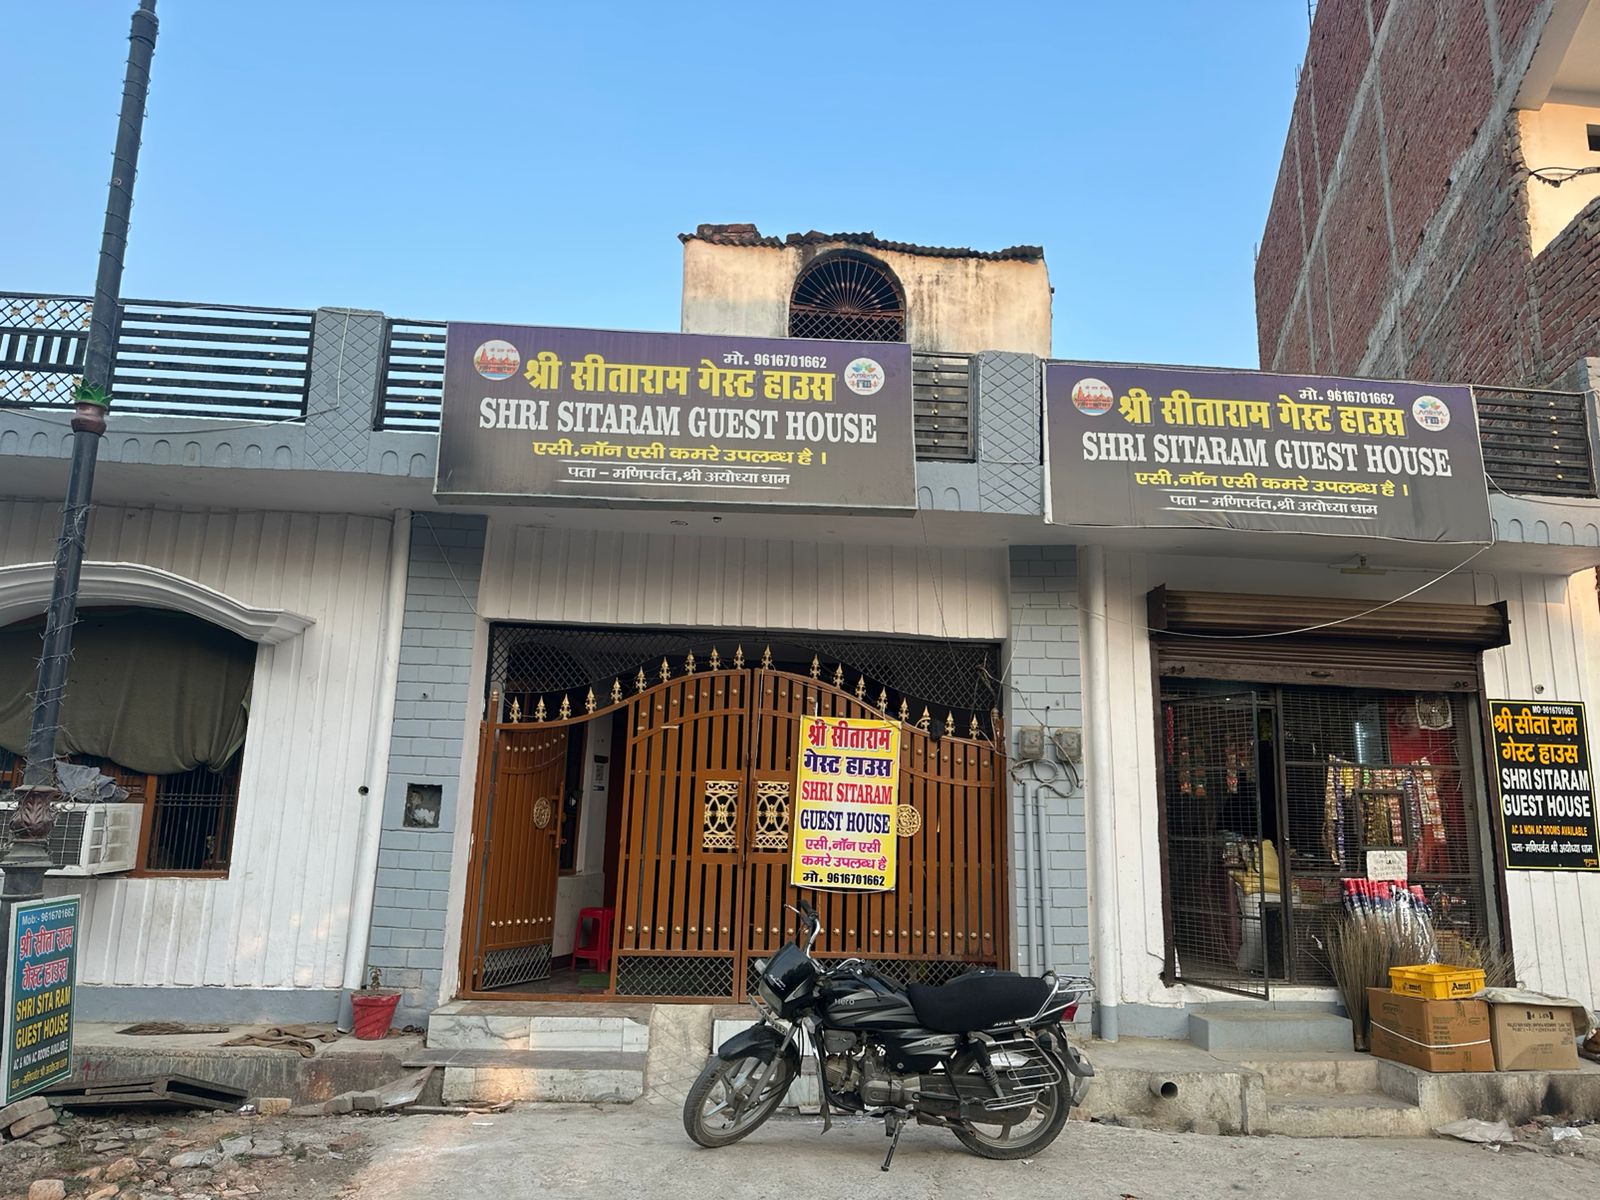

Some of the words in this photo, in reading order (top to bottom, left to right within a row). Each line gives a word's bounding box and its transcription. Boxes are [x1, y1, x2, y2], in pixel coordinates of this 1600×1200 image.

[723, 351, 749, 366] मो.
[754, 353, 827, 369] 9616701662
[524, 351, 563, 390] श्री
[570, 354, 691, 396] सीताराम
[698, 359, 756, 398] गेस्ट
[763, 371, 836, 402] हाउस
[1298, 387, 1324, 401] मो.
[1327, 389, 1396, 405] 9616701662
[479, 397, 549, 431] SHRI
[557, 401, 681, 436] SITARAM
[688, 407, 778, 440] GUEST
[785, 411, 877, 444] HOUSE
[1118, 388, 1153, 424] श्री
[1160, 390, 1271, 429] सीताराम
[1277, 394, 1332, 431] गेस्ट
[1337, 406, 1406, 437] हाउस
[627, 442, 666, 460] एसी
[669, 445, 719, 462] कमरे
[723, 450, 795, 464] उपलब्ध
[797, 448, 813, 466] है
[1082, 431, 1148, 462] SHRI
[1153, 434, 1269, 467] SITARAM
[1275, 439, 1359, 472] GUEST
[1363, 444, 1453, 477] HOUSE
[568, 466, 597, 479] पता
[705, 470, 759, 485] अयोध्या
[761, 473, 791, 485] धाम
[1220, 472, 1258, 489] एसी
[1261, 476, 1310, 492] कमरे
[1313, 481, 1379, 496] उपलब्ध
[1381, 480, 1396, 497] है
[1170, 495, 1197, 506] पता
[1297, 499, 1349, 514] अयोध्या
[1351, 503, 1378, 515] धाम
[1494, 707, 1513, 734] श्री
[1514, 707, 1549, 735] सीता
[1551, 716, 1578, 736] राम
[808, 719, 827, 747] श्री
[831, 721, 892, 750] सीताराम
[1501, 735, 1535, 763] गेस्ट
[1537, 744, 1578, 765] हाउस
[803, 749, 842, 774] गेस्ट
[845, 757, 893, 777] हाउस
[1502, 768, 1533, 790] SHRI
[1533, 768, 1590, 791] SITARAM
[802, 781, 833, 802] SHRI
[836, 783, 893, 805] SITARAM
[1503, 794, 1544, 816] GUEST
[1546, 795, 1591, 817] HOUSE
[800, 809, 844, 831] GUEST
[846, 812, 891, 834] HOUSE
[858, 839, 881, 853] एसी
[801, 853, 832, 867] कमरे
[833, 857, 876, 869] उपलब्ध
[877, 856, 887, 871] है
[803, 870, 823, 883] मो.
[827, 873, 885, 887] 9616701662
[41, 907, 75, 922] 9616701662
[19, 928, 33, 960] श्री
[34, 925, 56, 957] सीता
[1452, 982, 1471, 991] Amul
[16, 997, 35, 1022] SHRI
[37, 991, 53, 1015] SITA
[55, 986, 71, 1009] RAM
[16, 1021, 42, 1050] GUEST
[43, 1012, 68, 1040] HOUSE
